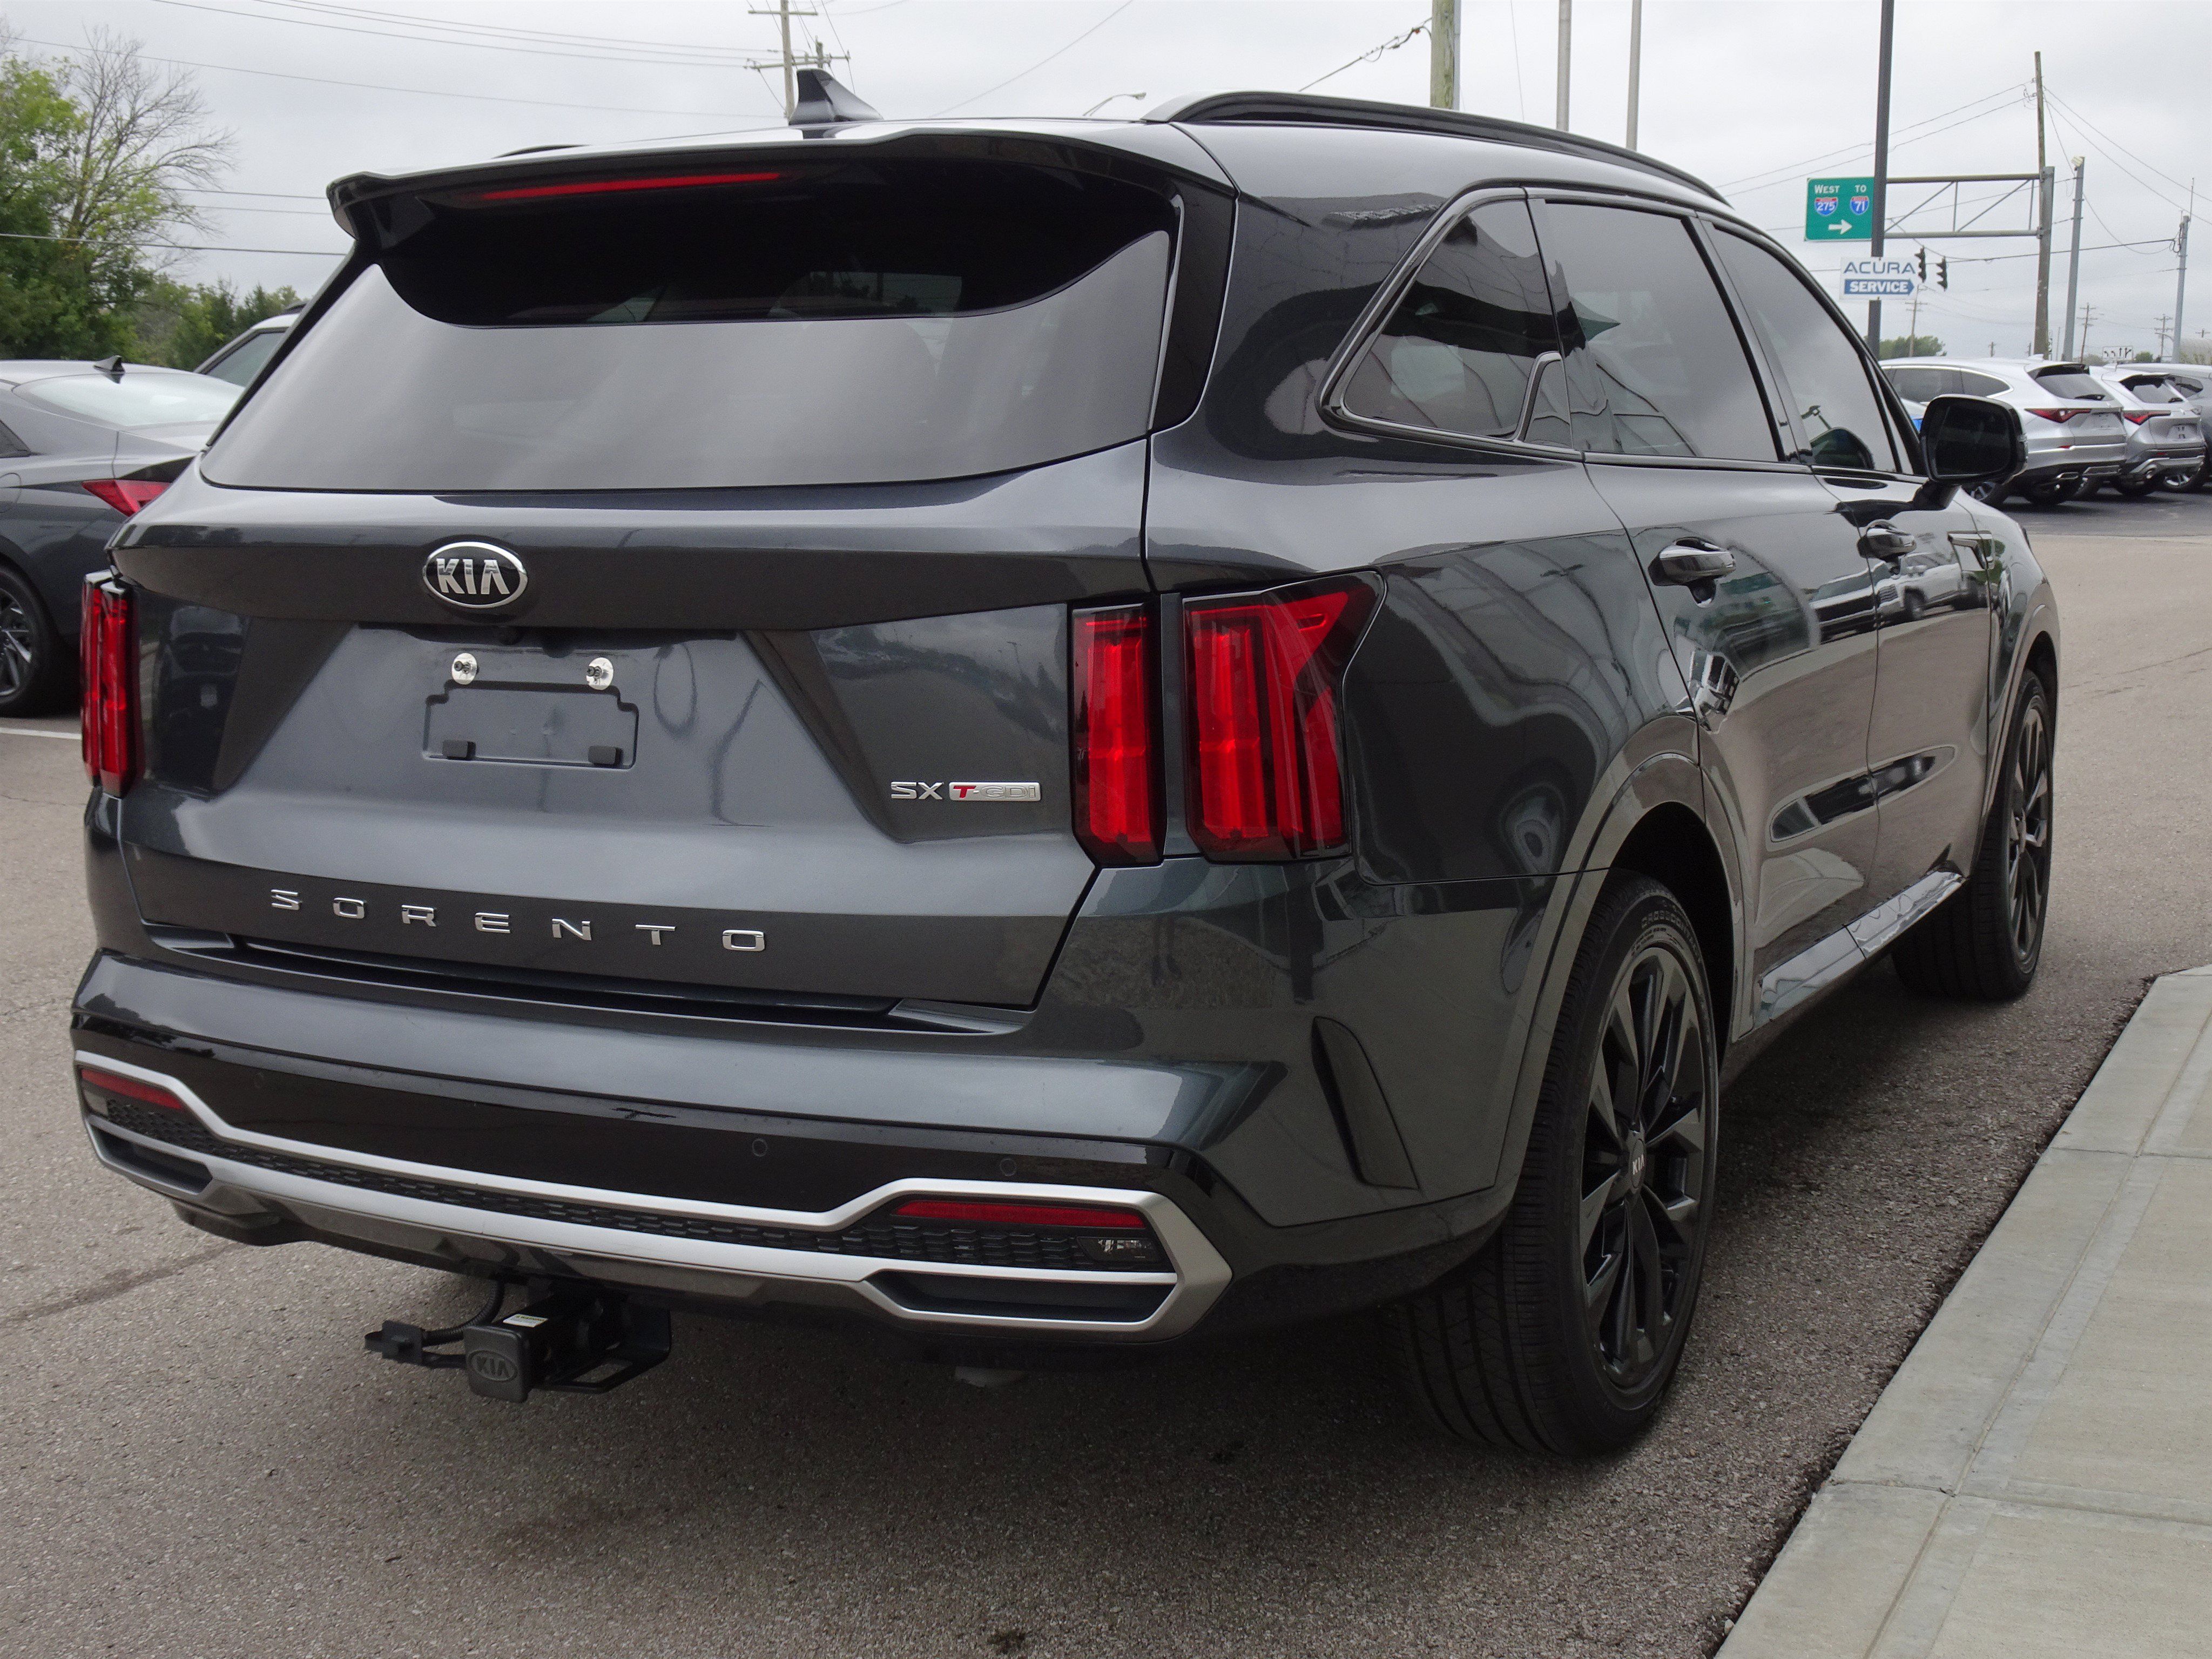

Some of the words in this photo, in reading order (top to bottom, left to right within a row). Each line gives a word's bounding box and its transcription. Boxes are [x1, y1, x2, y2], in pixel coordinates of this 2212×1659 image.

[1814, 184, 1840, 194] WEST
[1854, 184, 1867, 193] TO
[1817, 201, 1836, 211] 275
[1854, 200, 1865, 211] 71
[1843, 261, 1916, 274] ACURA
[1850, 281, 1909, 293] SERVICE
[436, 557, 510, 595] KIA
[891, 781, 944, 800] SX
[952, 785, 1036, 799] T-GDI
[271, 888, 765, 952] SORENTO
[1632, 1154, 1645, 1175] KIA
[475, 1355, 509, 1378] KIA
